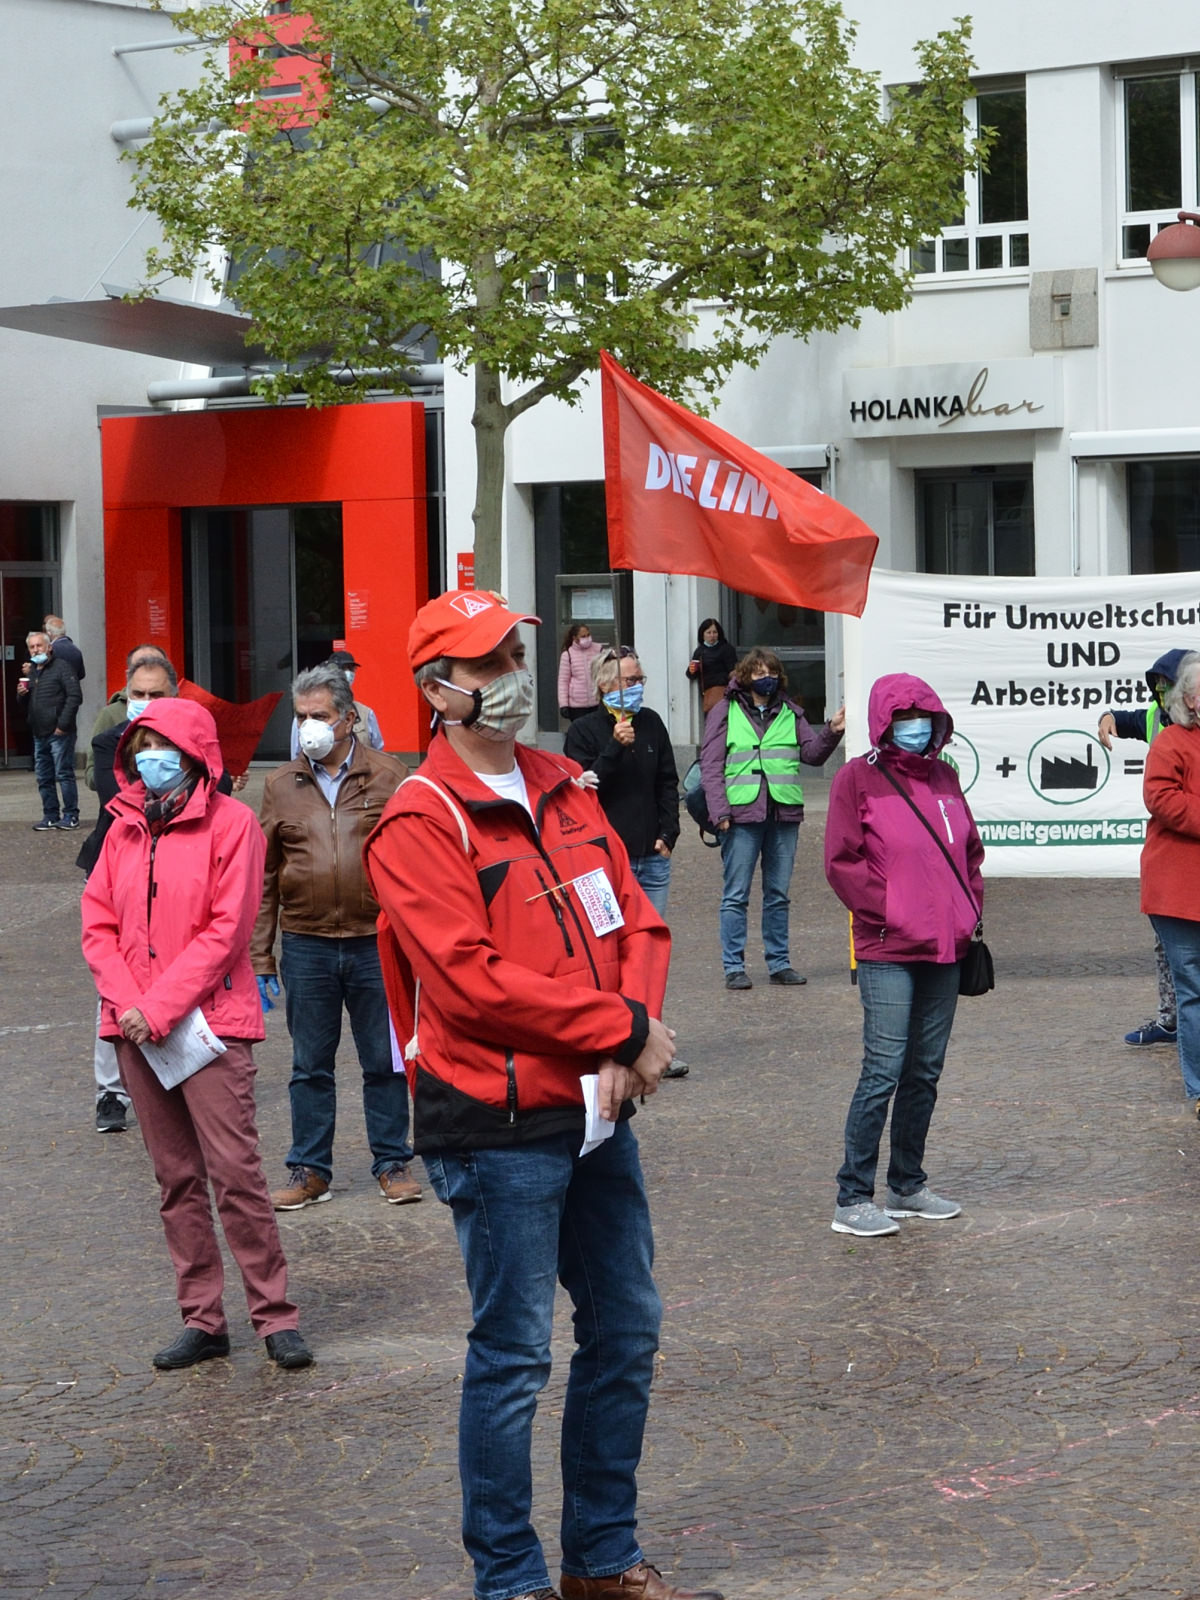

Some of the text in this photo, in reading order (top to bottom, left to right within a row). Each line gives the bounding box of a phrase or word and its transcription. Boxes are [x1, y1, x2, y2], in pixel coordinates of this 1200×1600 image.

[850, 395, 965, 422] HOLANKA
[645, 442, 698, 500] DIE
[943, 603, 996, 628] Für
[1047, 641, 1121, 668] UND
[970, 679, 1153, 710] Arbeitsplät
